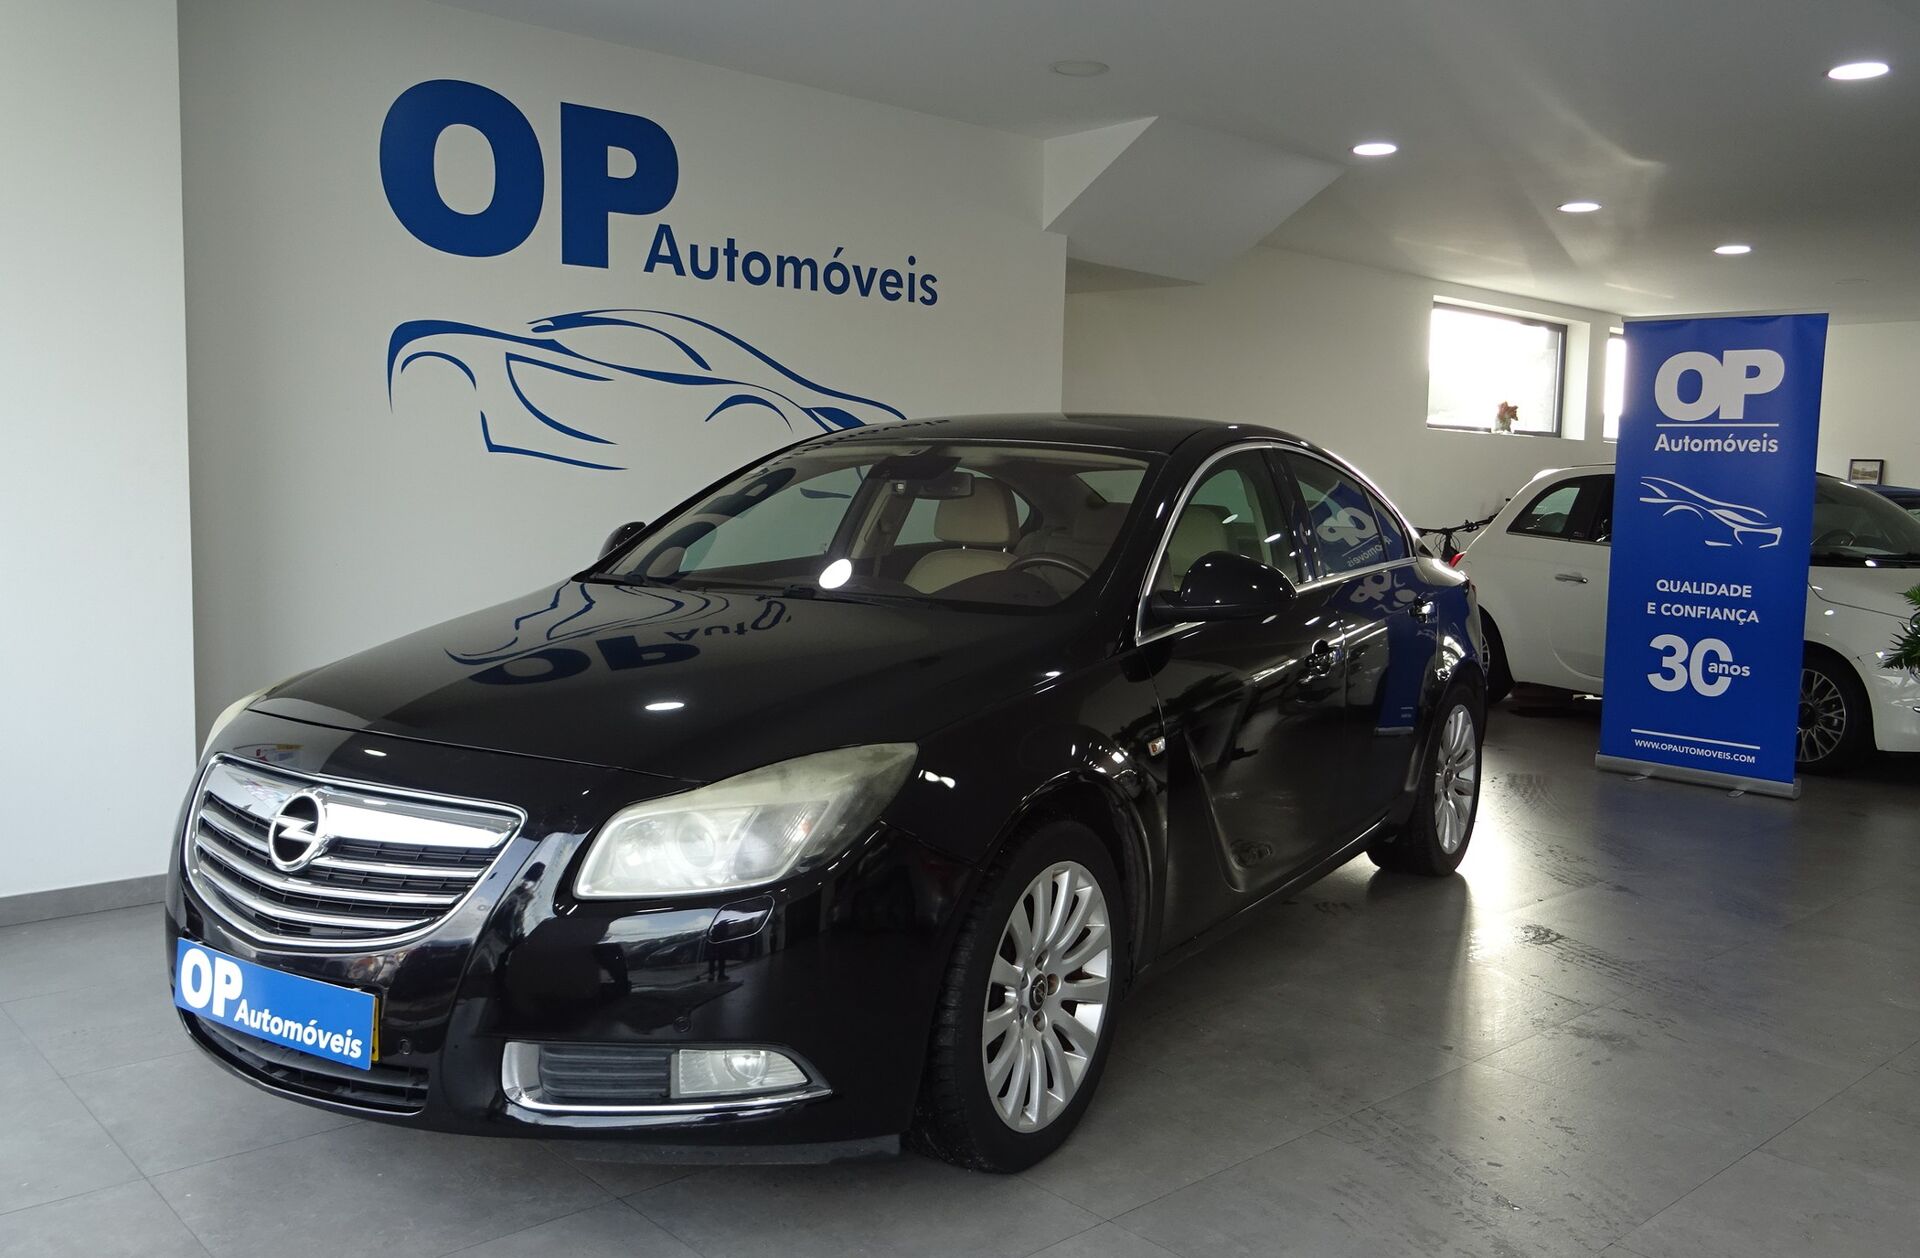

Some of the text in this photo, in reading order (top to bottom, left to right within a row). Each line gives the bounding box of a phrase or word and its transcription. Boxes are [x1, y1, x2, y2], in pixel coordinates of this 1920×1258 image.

[380, 79, 679, 269] OP
[643, 223, 938, 306] Automóveis
[1654, 349, 1785, 421] OP
[1654, 432, 1779, 453] Automóveis
[1647, 602, 1760, 624] E CONFIANÇA
[1656, 578, 1752, 598] QUALIDADE
[1647, 634, 1751, 697] 30 anos
[1634, 739, 1756, 763] WWW.OPAUTOMOVEIS.COM
[181, 947, 243, 1018] OP
[233, 998, 363, 1059] Automóveis
